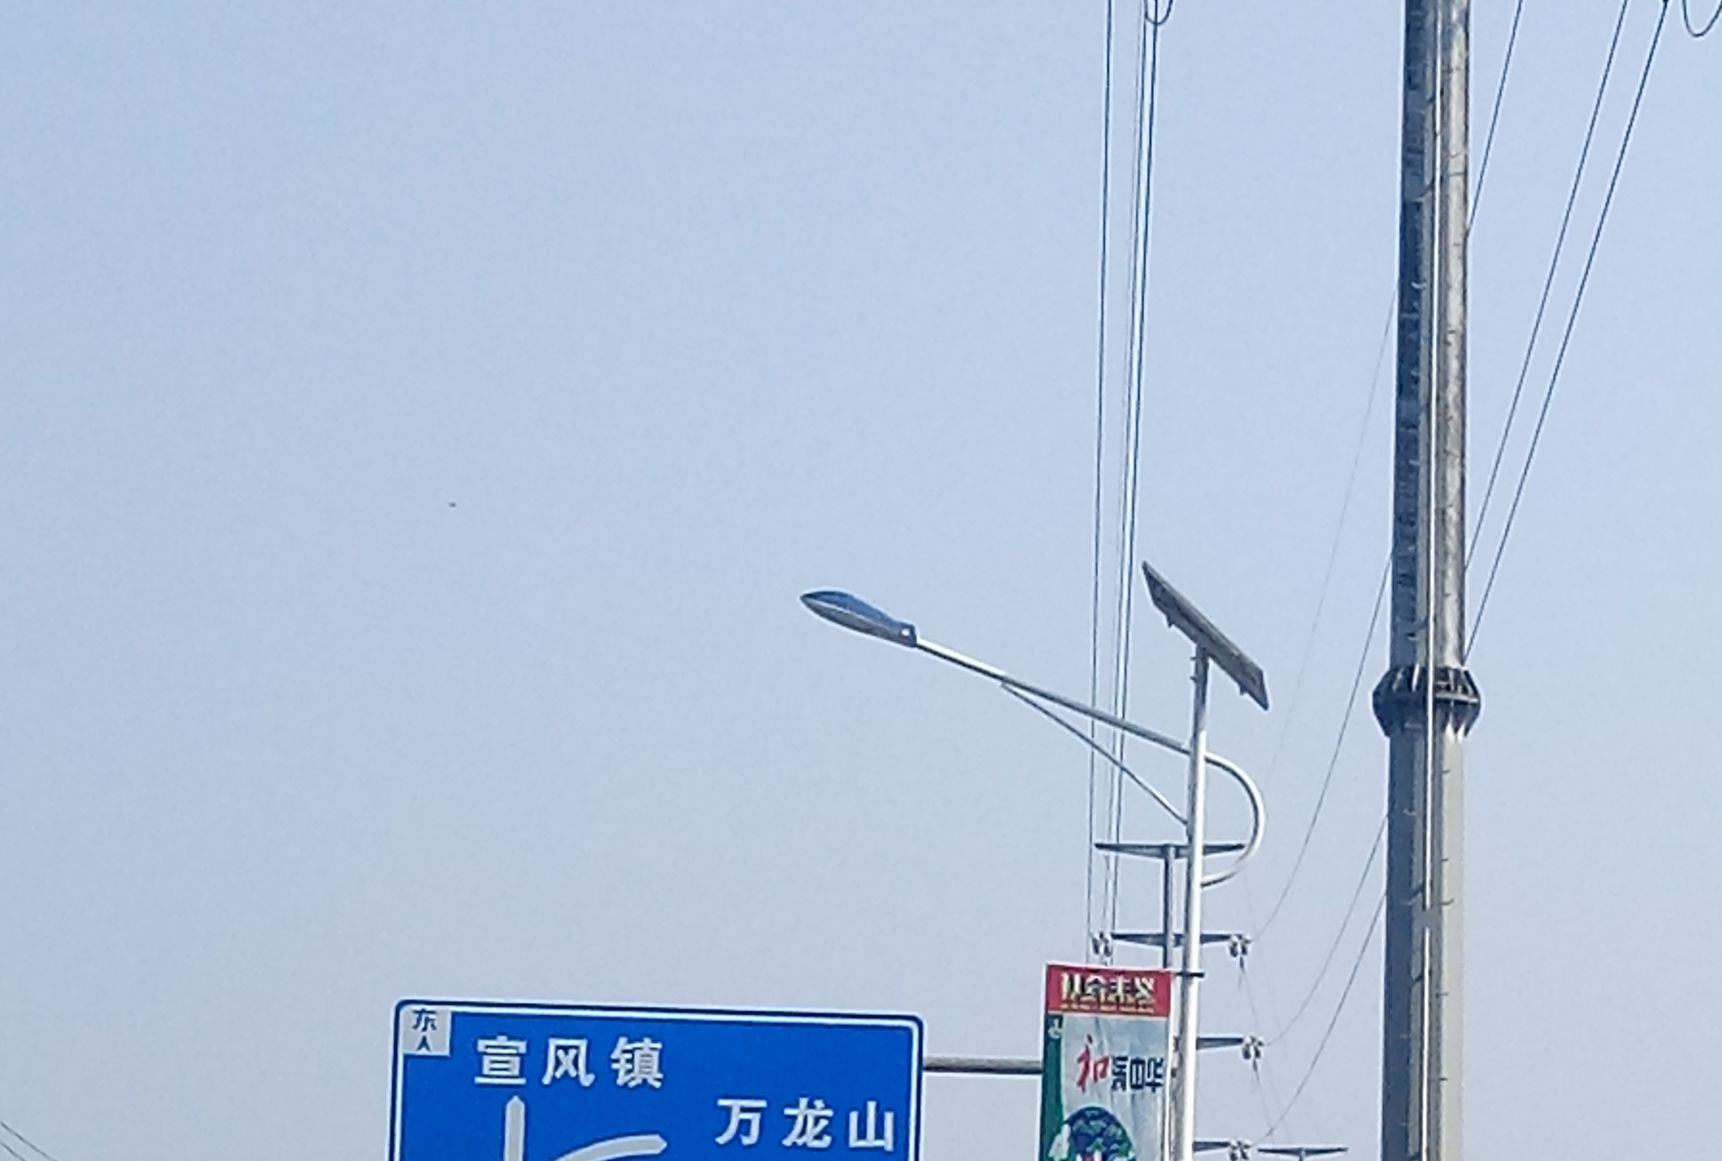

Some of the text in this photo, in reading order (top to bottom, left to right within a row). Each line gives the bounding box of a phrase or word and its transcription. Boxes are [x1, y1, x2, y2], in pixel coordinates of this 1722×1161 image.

[474, 1036, 664, 1088] 宣风镇
[715, 1097, 894, 1151] 万龙山
